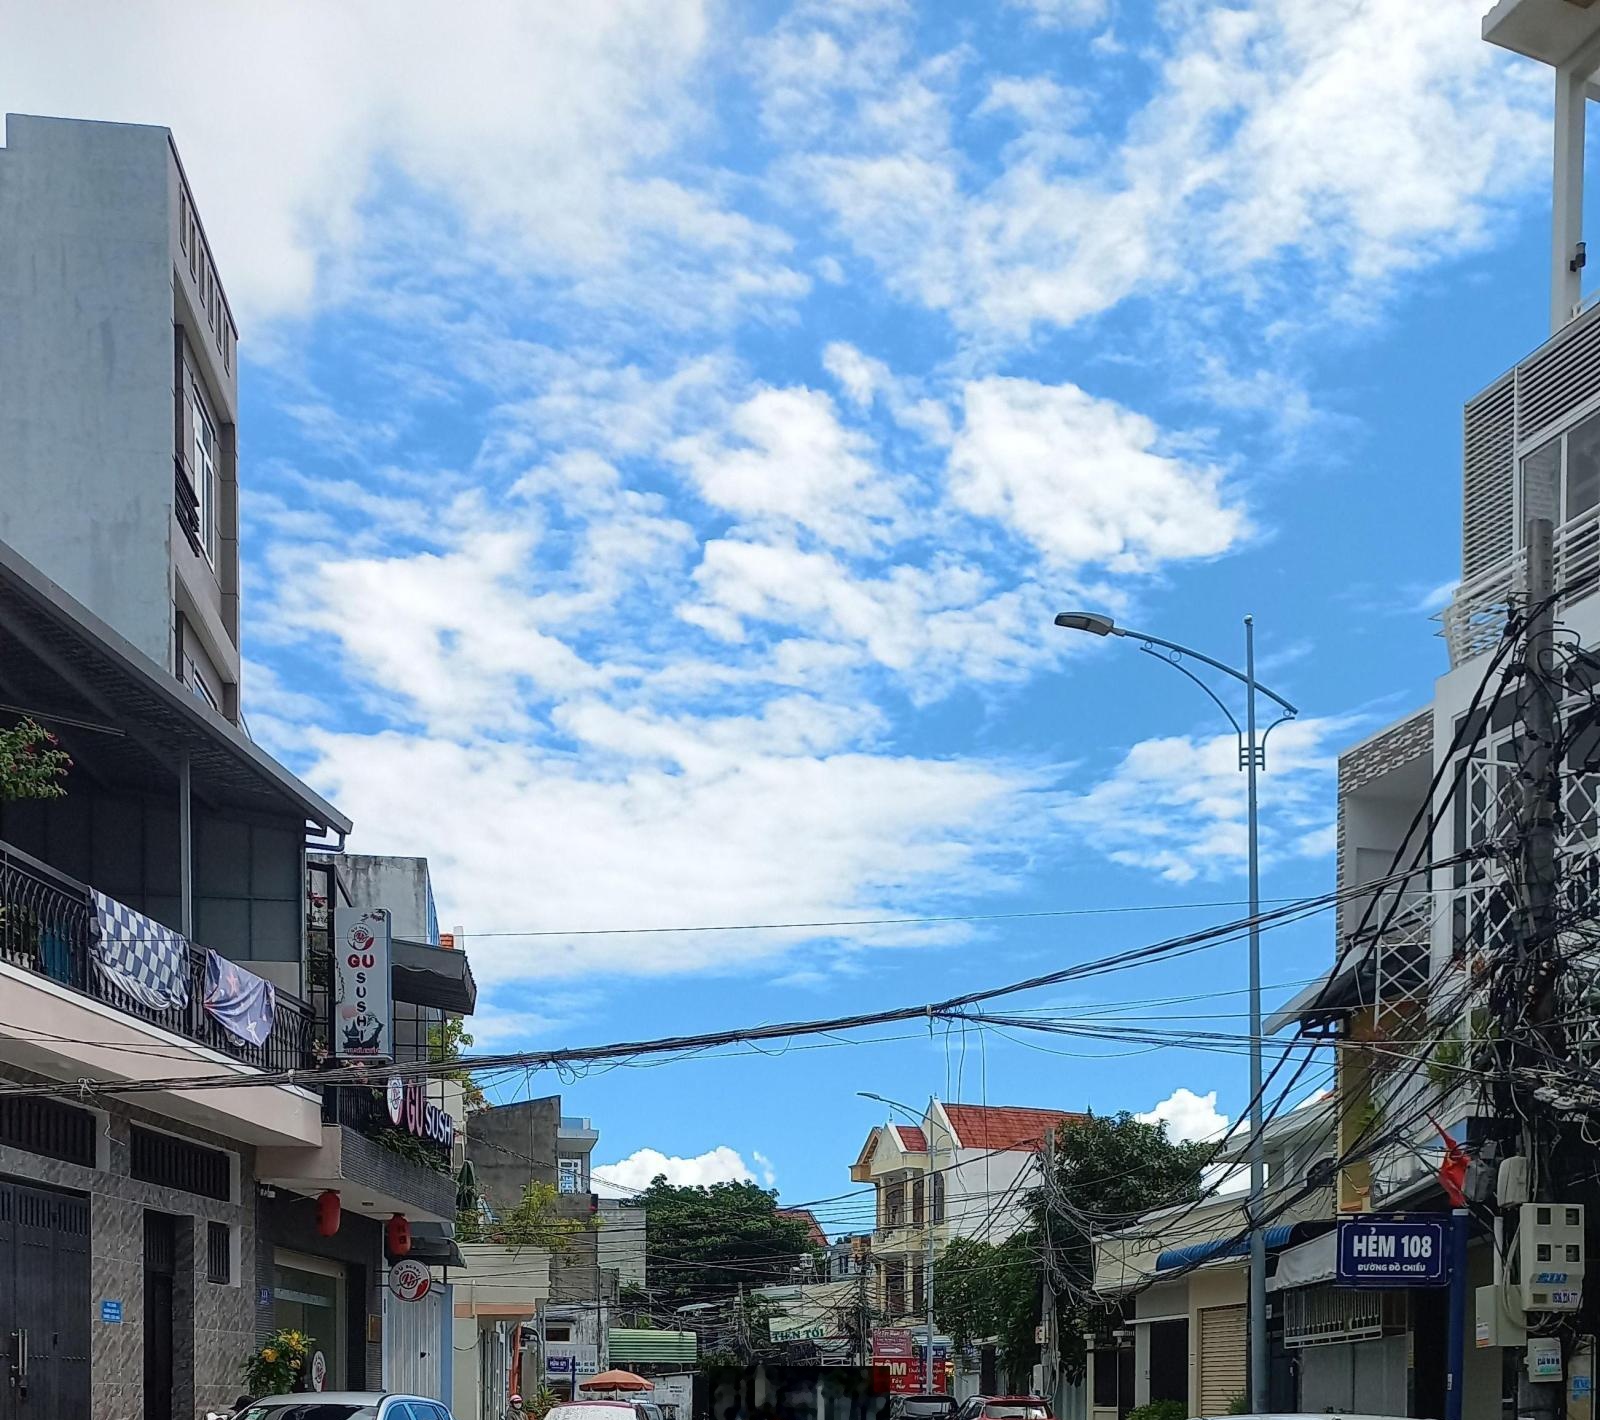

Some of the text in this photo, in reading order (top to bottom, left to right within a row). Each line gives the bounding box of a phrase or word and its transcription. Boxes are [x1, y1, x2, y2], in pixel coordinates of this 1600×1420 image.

[347, 953, 375, 969] GU
[355, 972, 367, 1042] SUSHI
[406, 1079, 454, 1149] GU SUSHI
[1353, 1226, 1432, 1258] HẺM 108
[1357, 1262, 1388, 1272] ĐƯỜNG
[1388, 1261, 1401, 1272] ĐỒ
